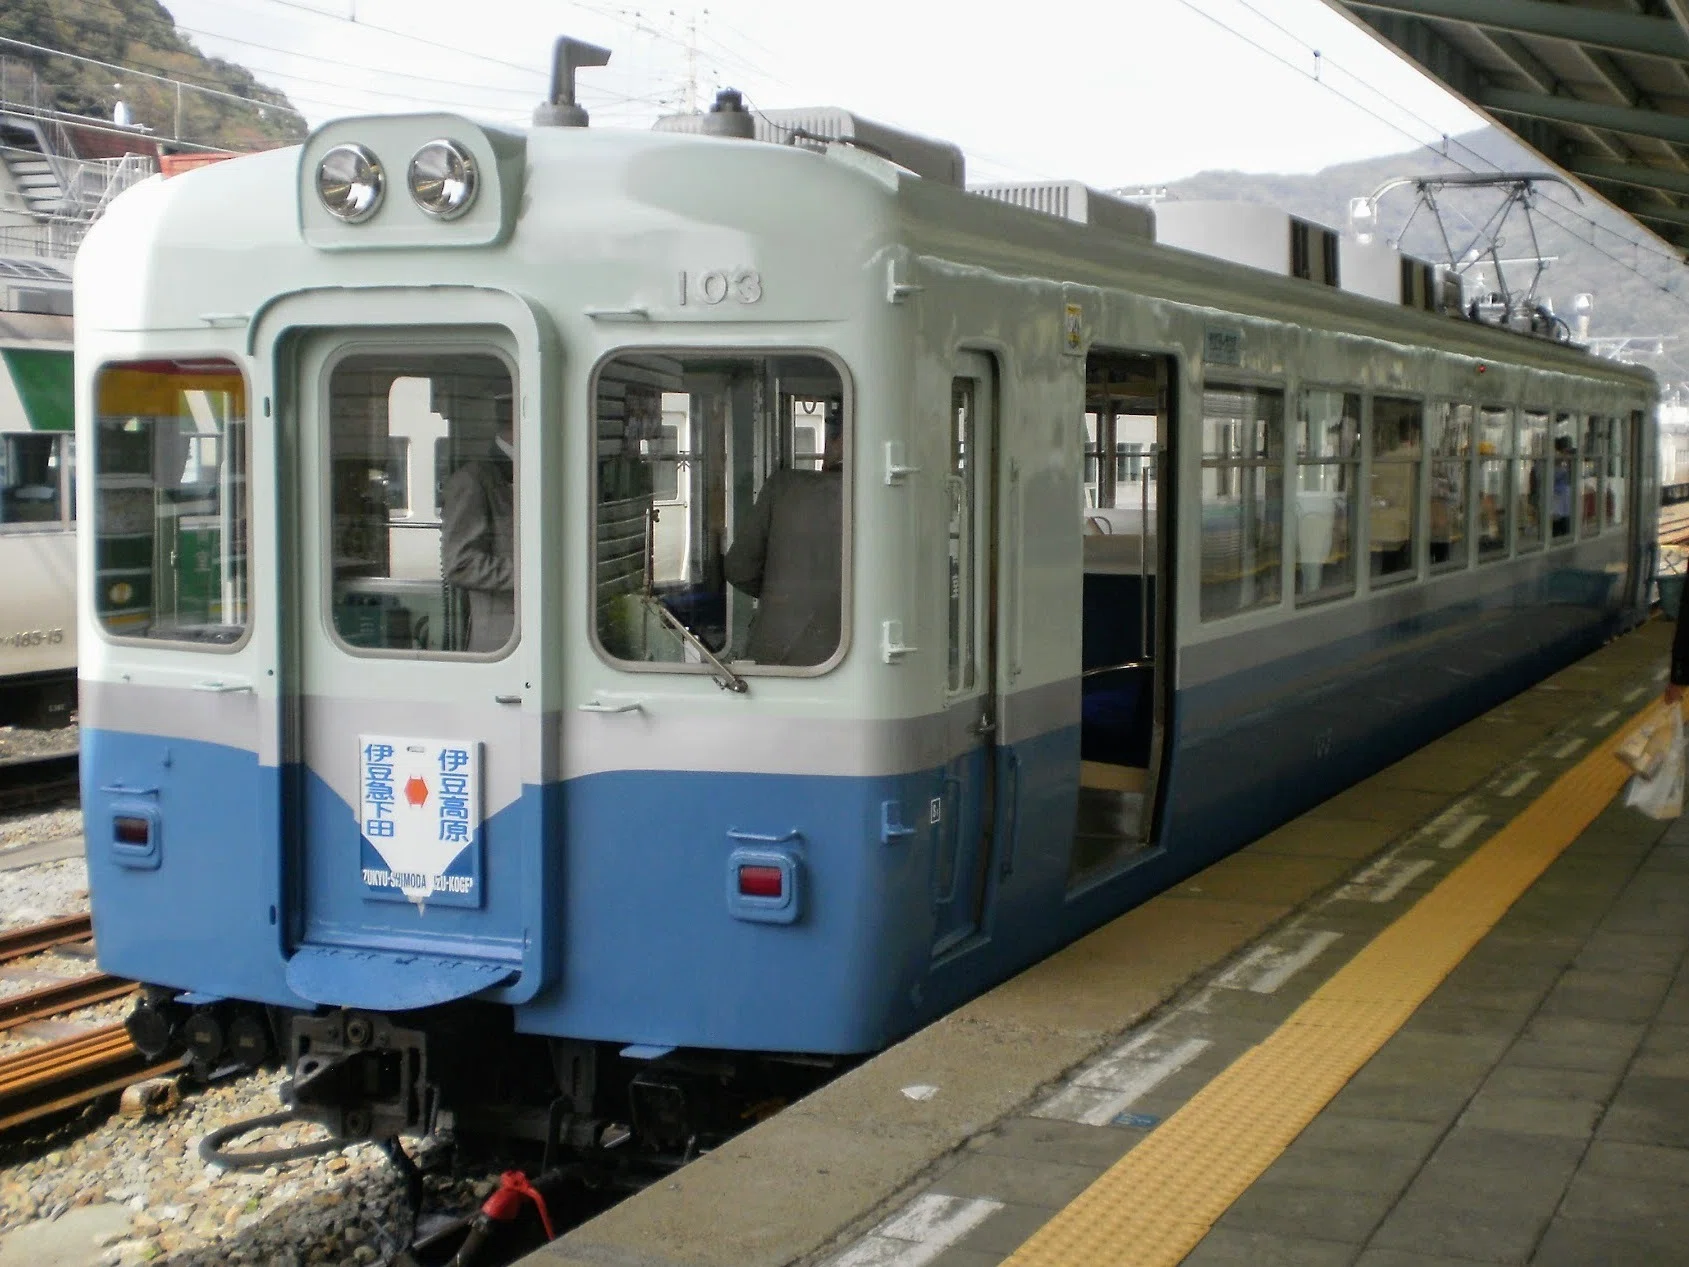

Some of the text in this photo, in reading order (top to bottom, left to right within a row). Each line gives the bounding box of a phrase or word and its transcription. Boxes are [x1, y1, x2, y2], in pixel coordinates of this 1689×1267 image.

[679, 270, 763, 306] 103
[364, 743, 395, 837] 伊豆急下田
[438, 749, 469, 842] 伊豆高原
